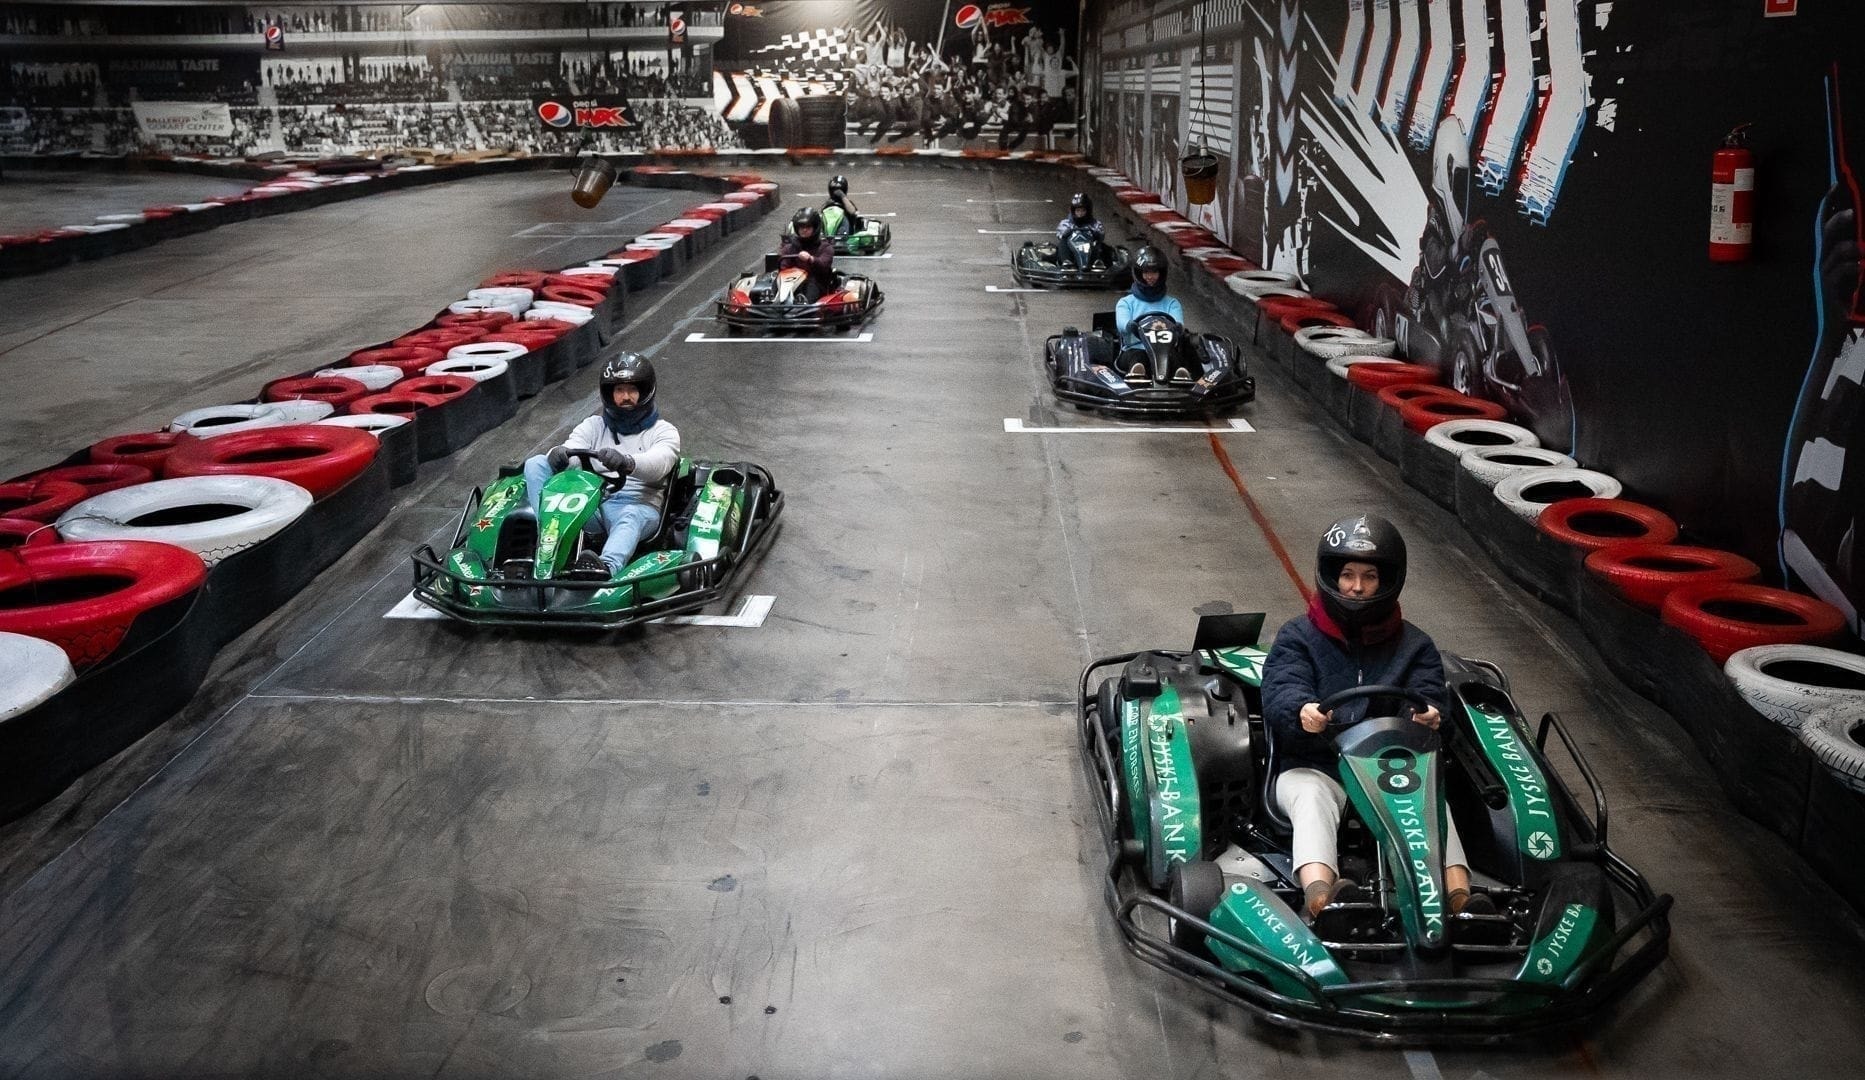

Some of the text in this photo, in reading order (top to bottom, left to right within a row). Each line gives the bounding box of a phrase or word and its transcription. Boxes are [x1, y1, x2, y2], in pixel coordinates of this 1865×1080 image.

[181, 59, 220, 71] TASTE
[441, 53, 554, 65] MAXIMUM TASTE
[187, 123, 225, 131] CENTER
[1145, 330, 1174, 344] 13
[543, 492, 589, 513] 10
[1323, 523, 1347, 547] XS
[1129, 730, 1138, 744] EN
[1377, 747, 1422, 795] 8
[1484, 714, 1549, 818] JYSKE BANK
[1151, 737, 1187, 865] JYSKE BANK
[1393, 798, 1430, 852] JYSKE
[1245, 896, 1319, 969] JYSKE BAN
[1548, 917, 1575, 958] JYSKE
